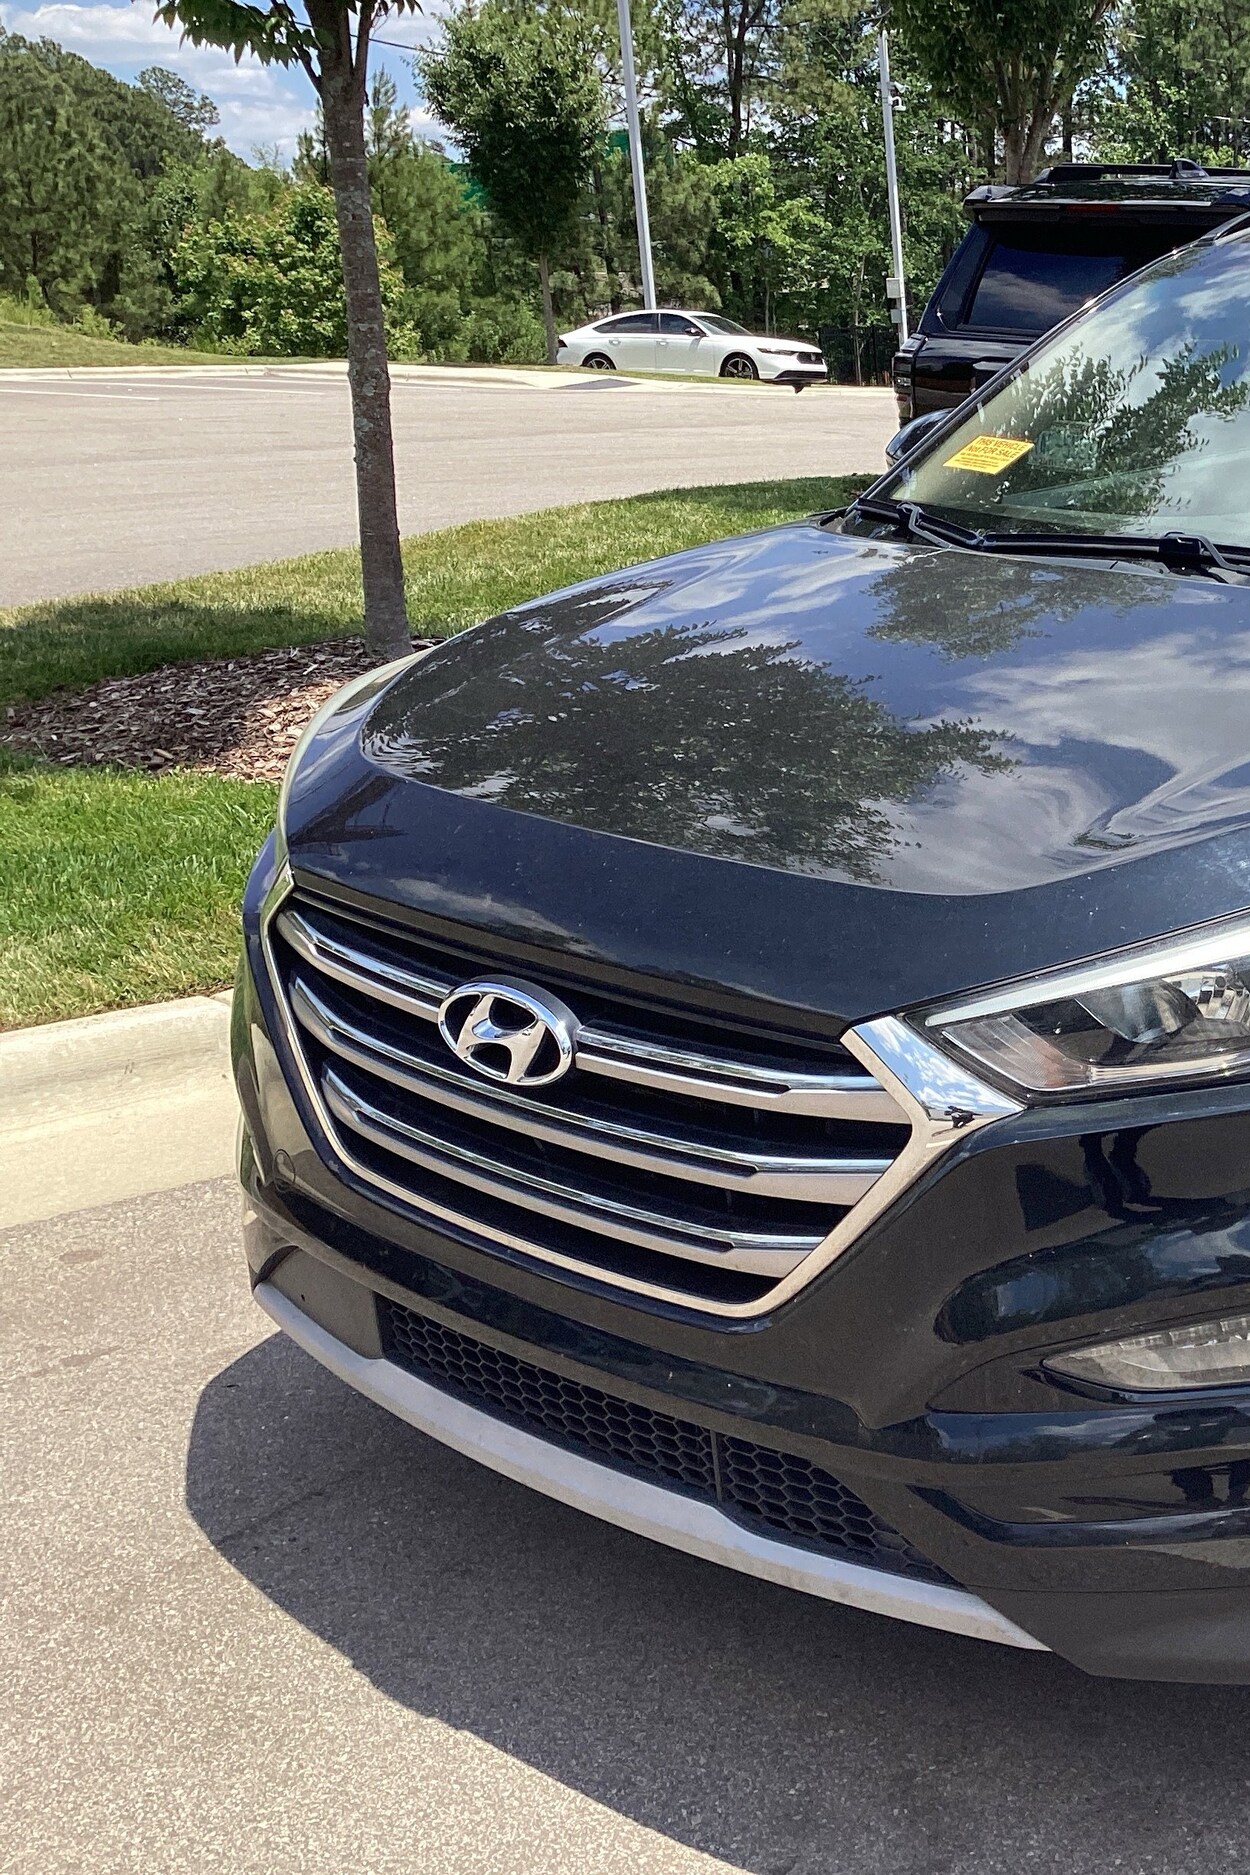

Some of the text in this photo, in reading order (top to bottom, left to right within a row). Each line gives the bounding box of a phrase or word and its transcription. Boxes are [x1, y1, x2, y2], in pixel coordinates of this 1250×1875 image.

[993, 439, 1028, 452] VEHICLE
[978, 446, 998, 455] FOR
[996, 448, 1020, 459] SALE
